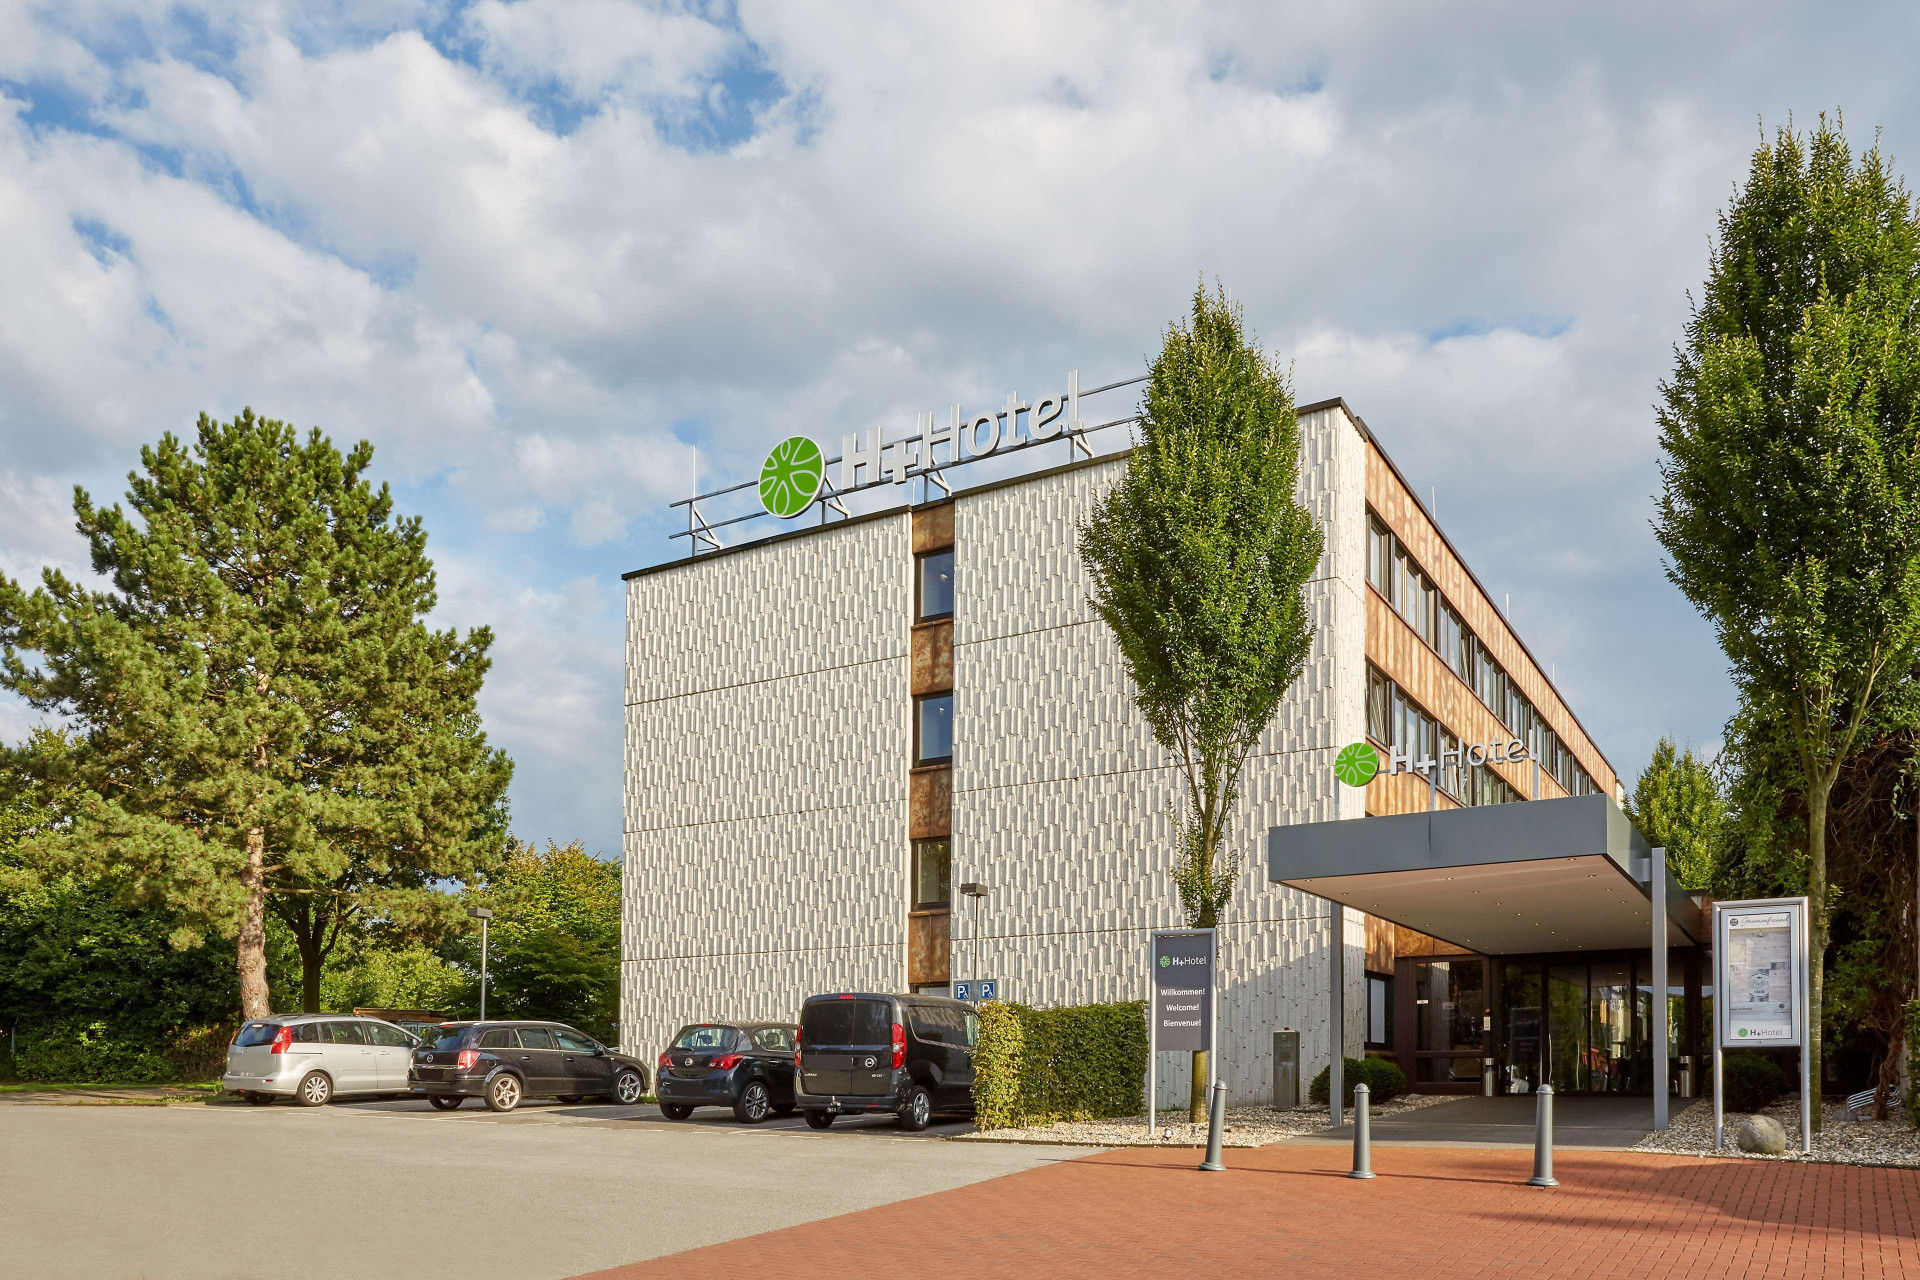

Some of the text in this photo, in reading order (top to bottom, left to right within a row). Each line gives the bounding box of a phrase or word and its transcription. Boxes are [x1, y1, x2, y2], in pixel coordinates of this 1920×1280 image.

[841, 369, 1084, 490] H+Hotel
[1389, 729, 1538, 776] H+Hotel
[1172, 955, 1207, 967] H+Hotel
[957, 985, 965, 998] P
[982, 984, 990, 997] P
[1160, 987, 1206, 996] Willkommen!
[1166, 1003, 1200, 1011] Welcome!
[1163, 1018, 1202, 1027] Bienvenue!
[1750, 1028, 1783, 1037] H+Hotel
